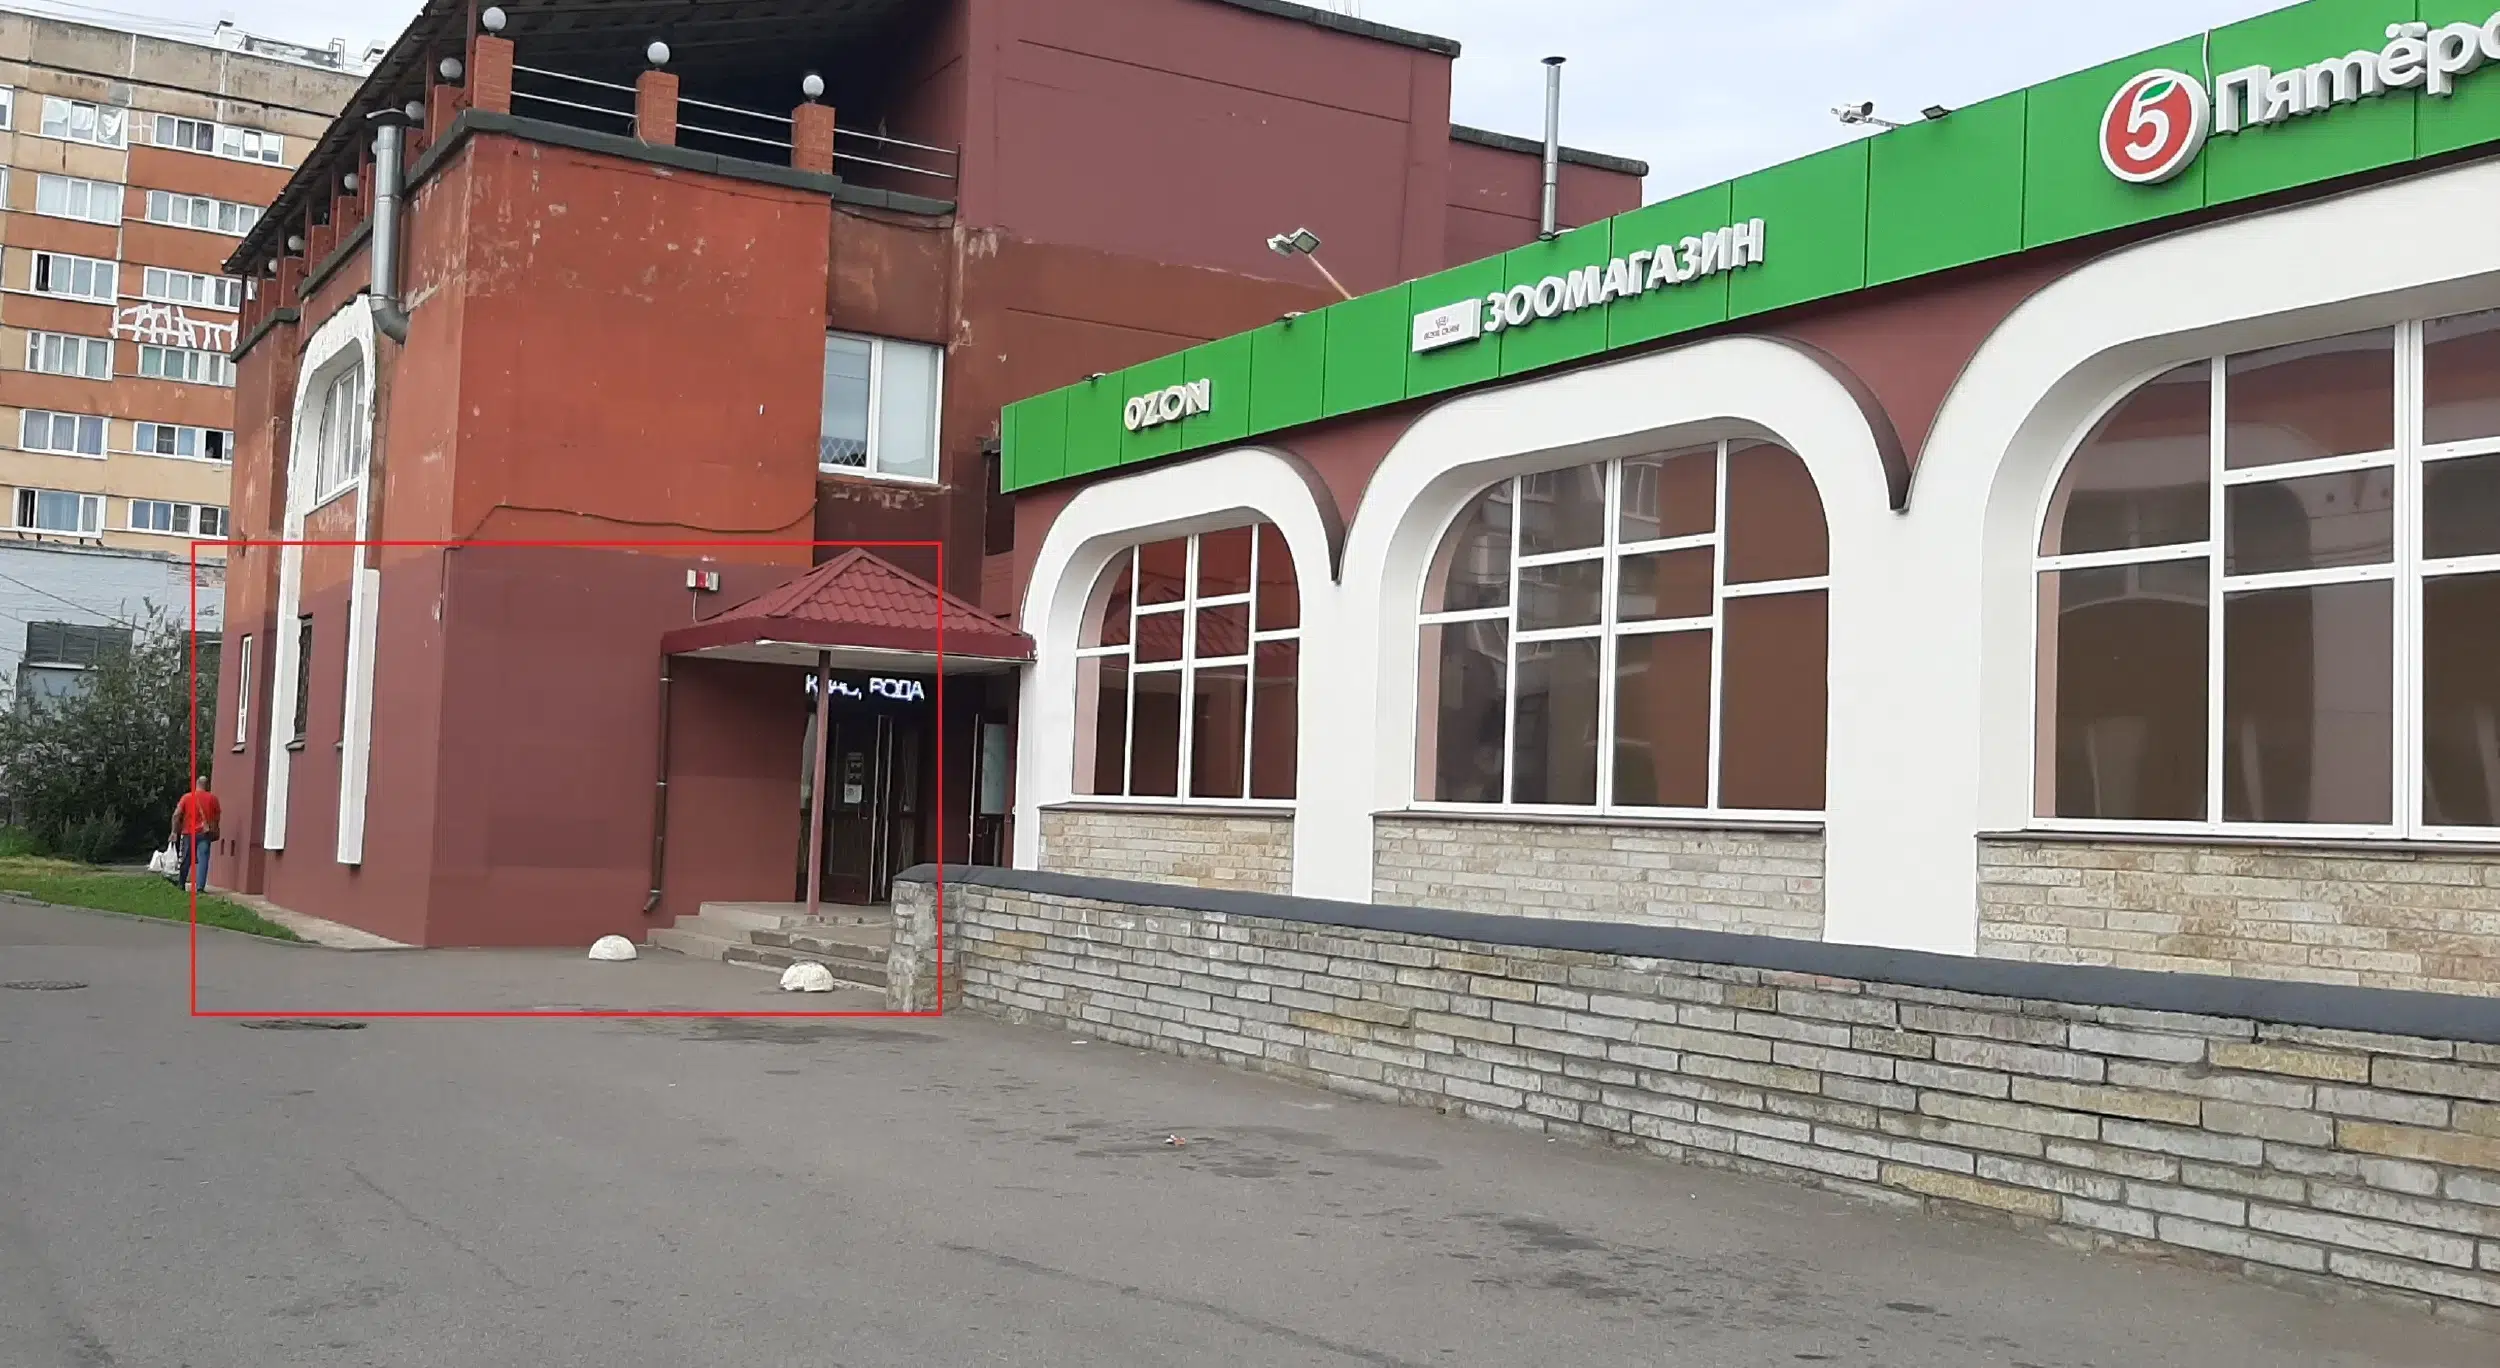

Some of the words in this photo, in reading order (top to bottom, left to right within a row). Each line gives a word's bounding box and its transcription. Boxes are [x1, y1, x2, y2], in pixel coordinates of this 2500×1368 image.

[2125, 79, 2176, 162] 5
[1484, 218, 1765, 333] ЗООМАГАЗИН
[1124, 378, 1210, 431] OZON
